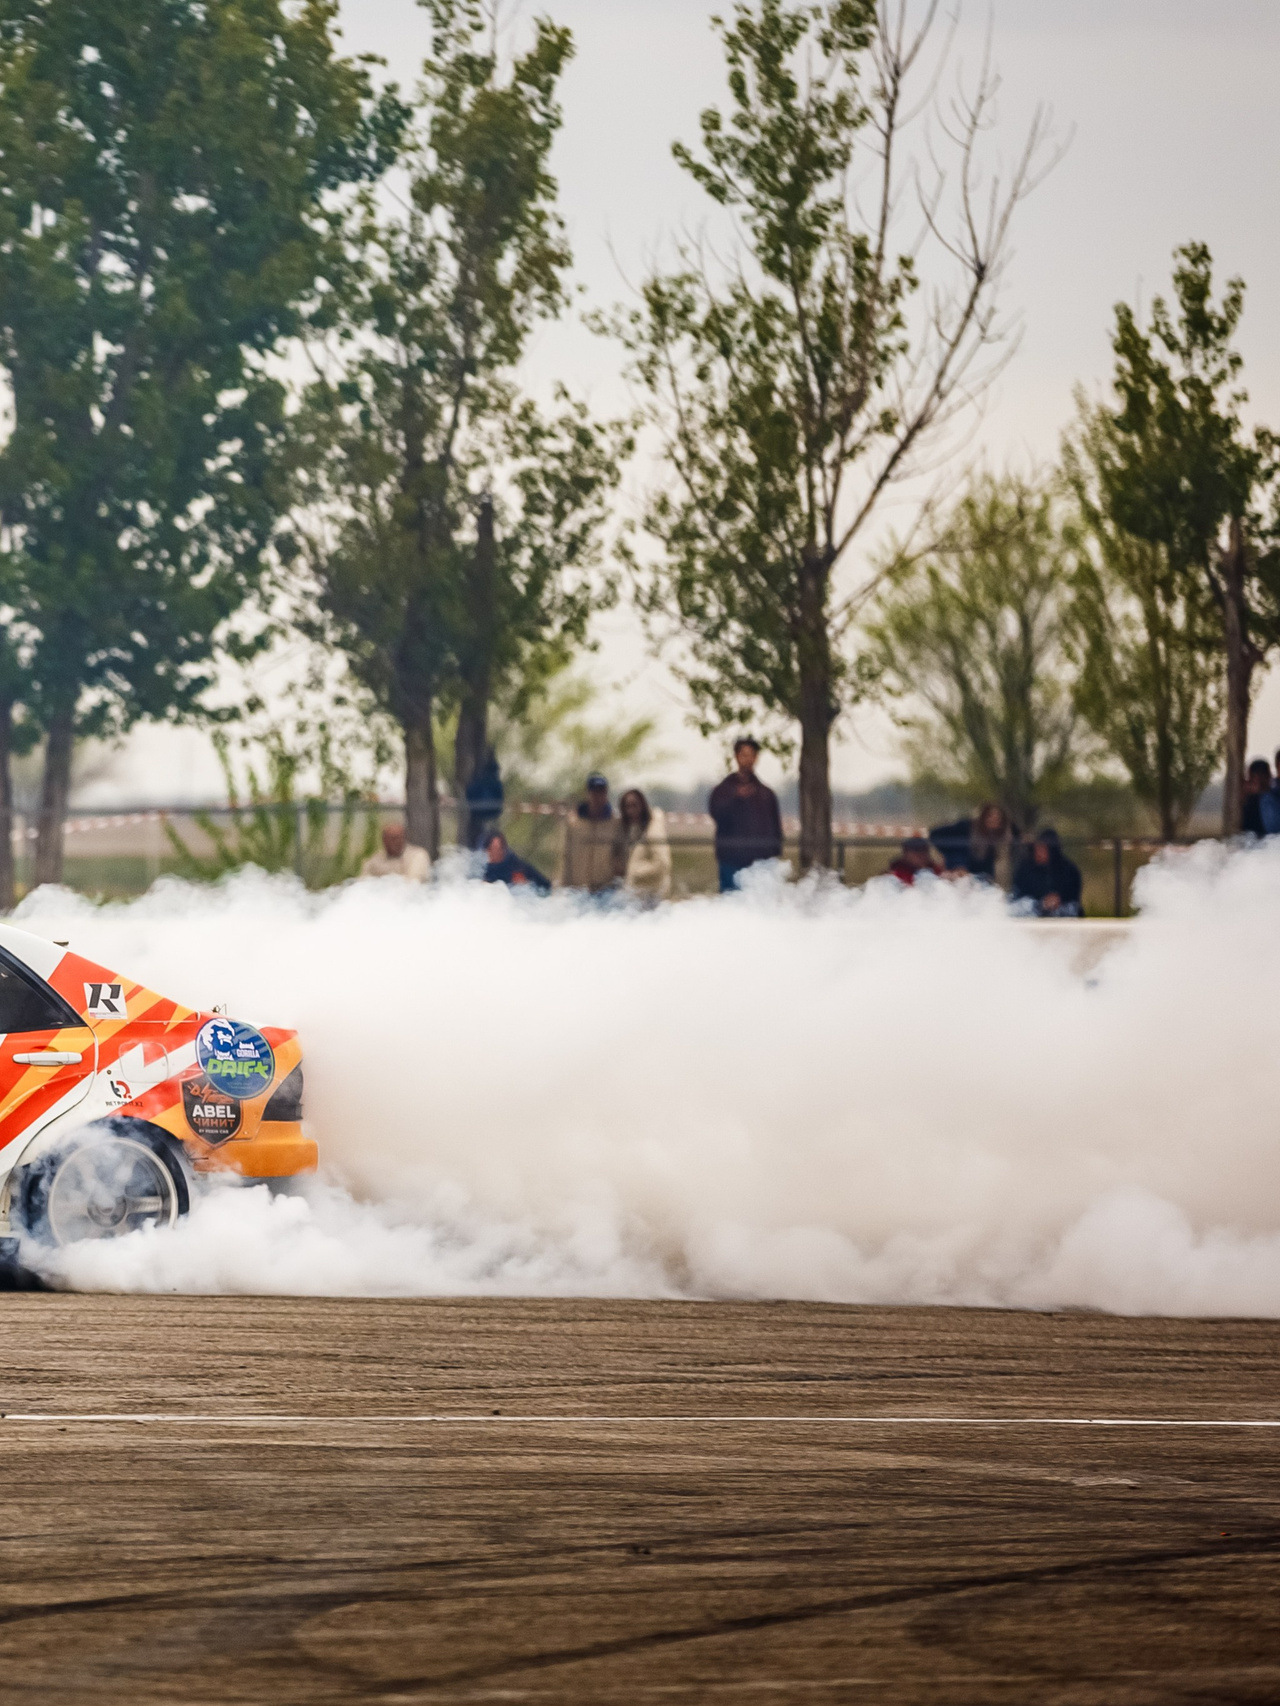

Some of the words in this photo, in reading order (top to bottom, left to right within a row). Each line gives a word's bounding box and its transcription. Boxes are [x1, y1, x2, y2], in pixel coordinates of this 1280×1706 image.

[236, 1048, 261, 1058] GORILLA
[192, 1104, 236, 1119] ABEL
[193, 1117, 236, 1129] ЧИНИТ
